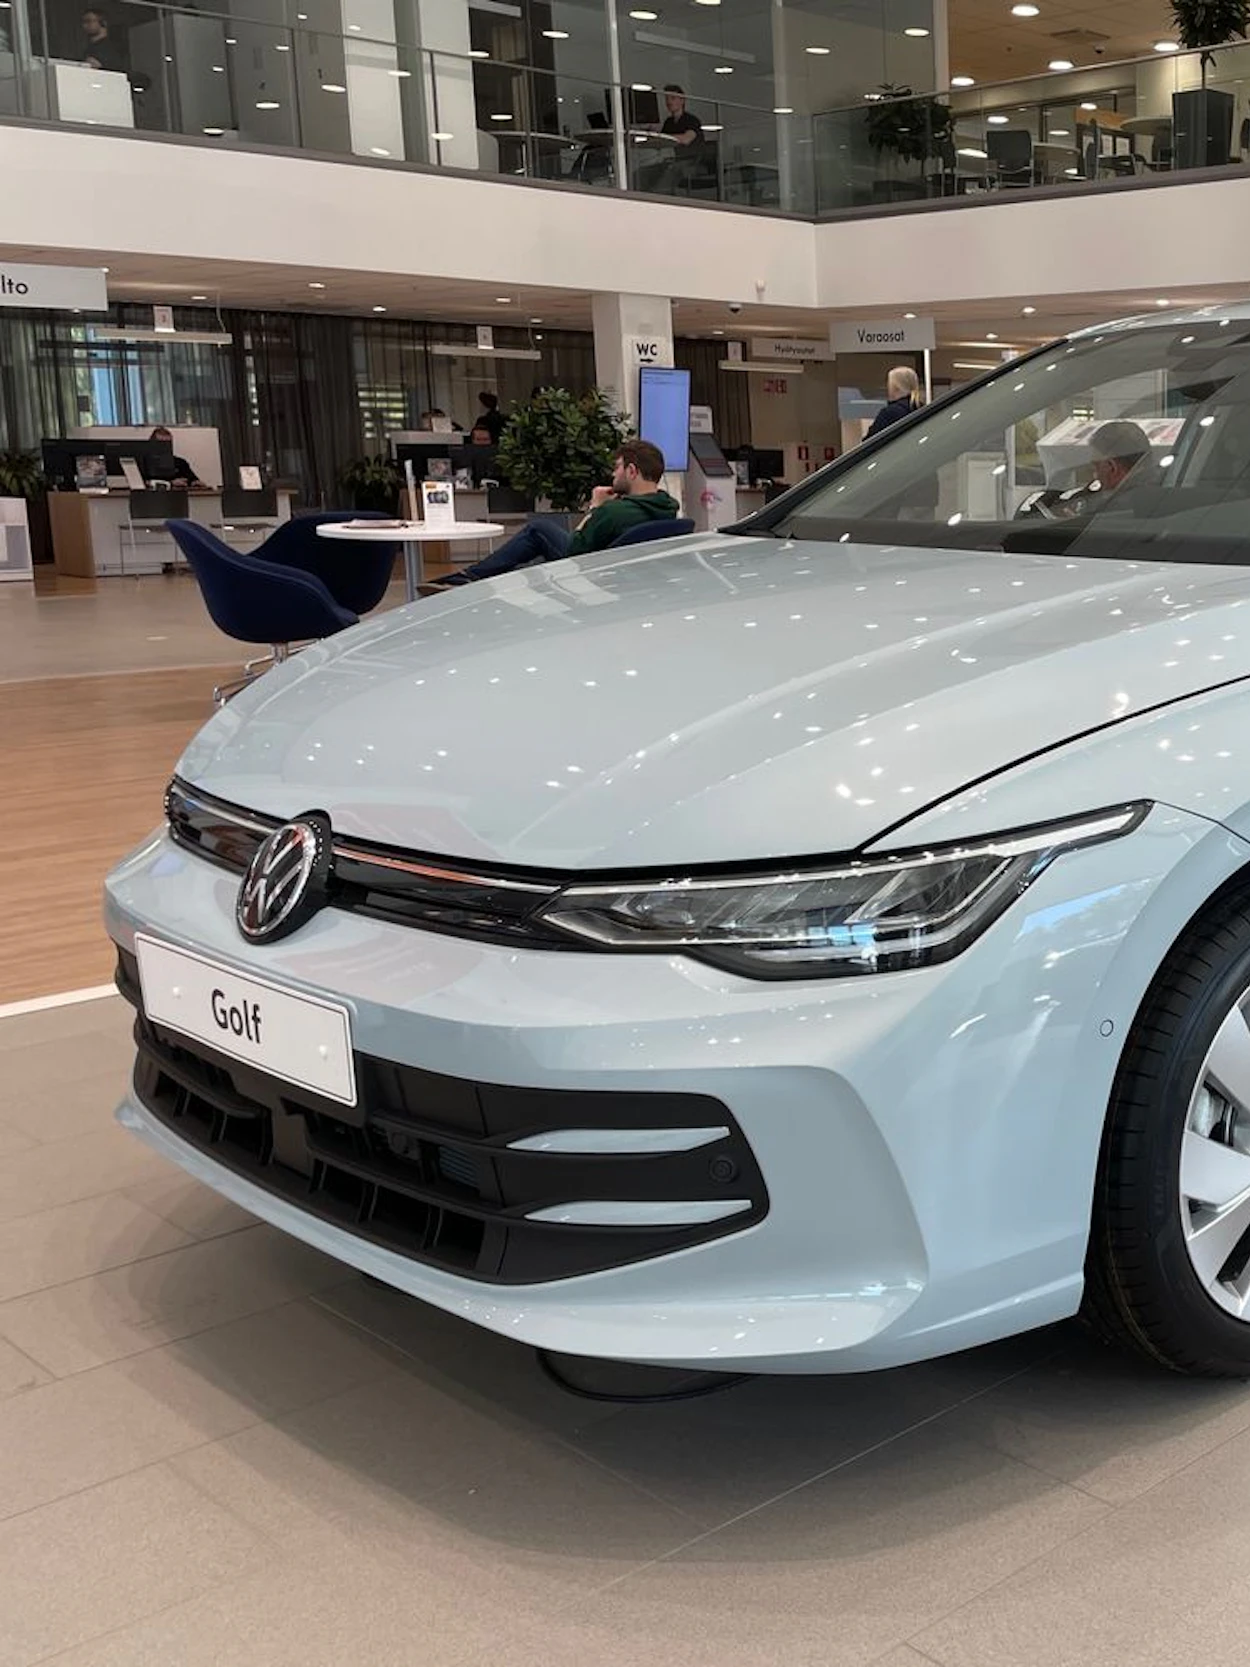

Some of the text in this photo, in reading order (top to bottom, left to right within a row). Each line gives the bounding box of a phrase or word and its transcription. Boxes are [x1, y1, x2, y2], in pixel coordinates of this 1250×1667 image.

[1, 274, 29, 295] lto
[636, 343, 657, 356] WC
[211, 988, 261, 1044] Golf
